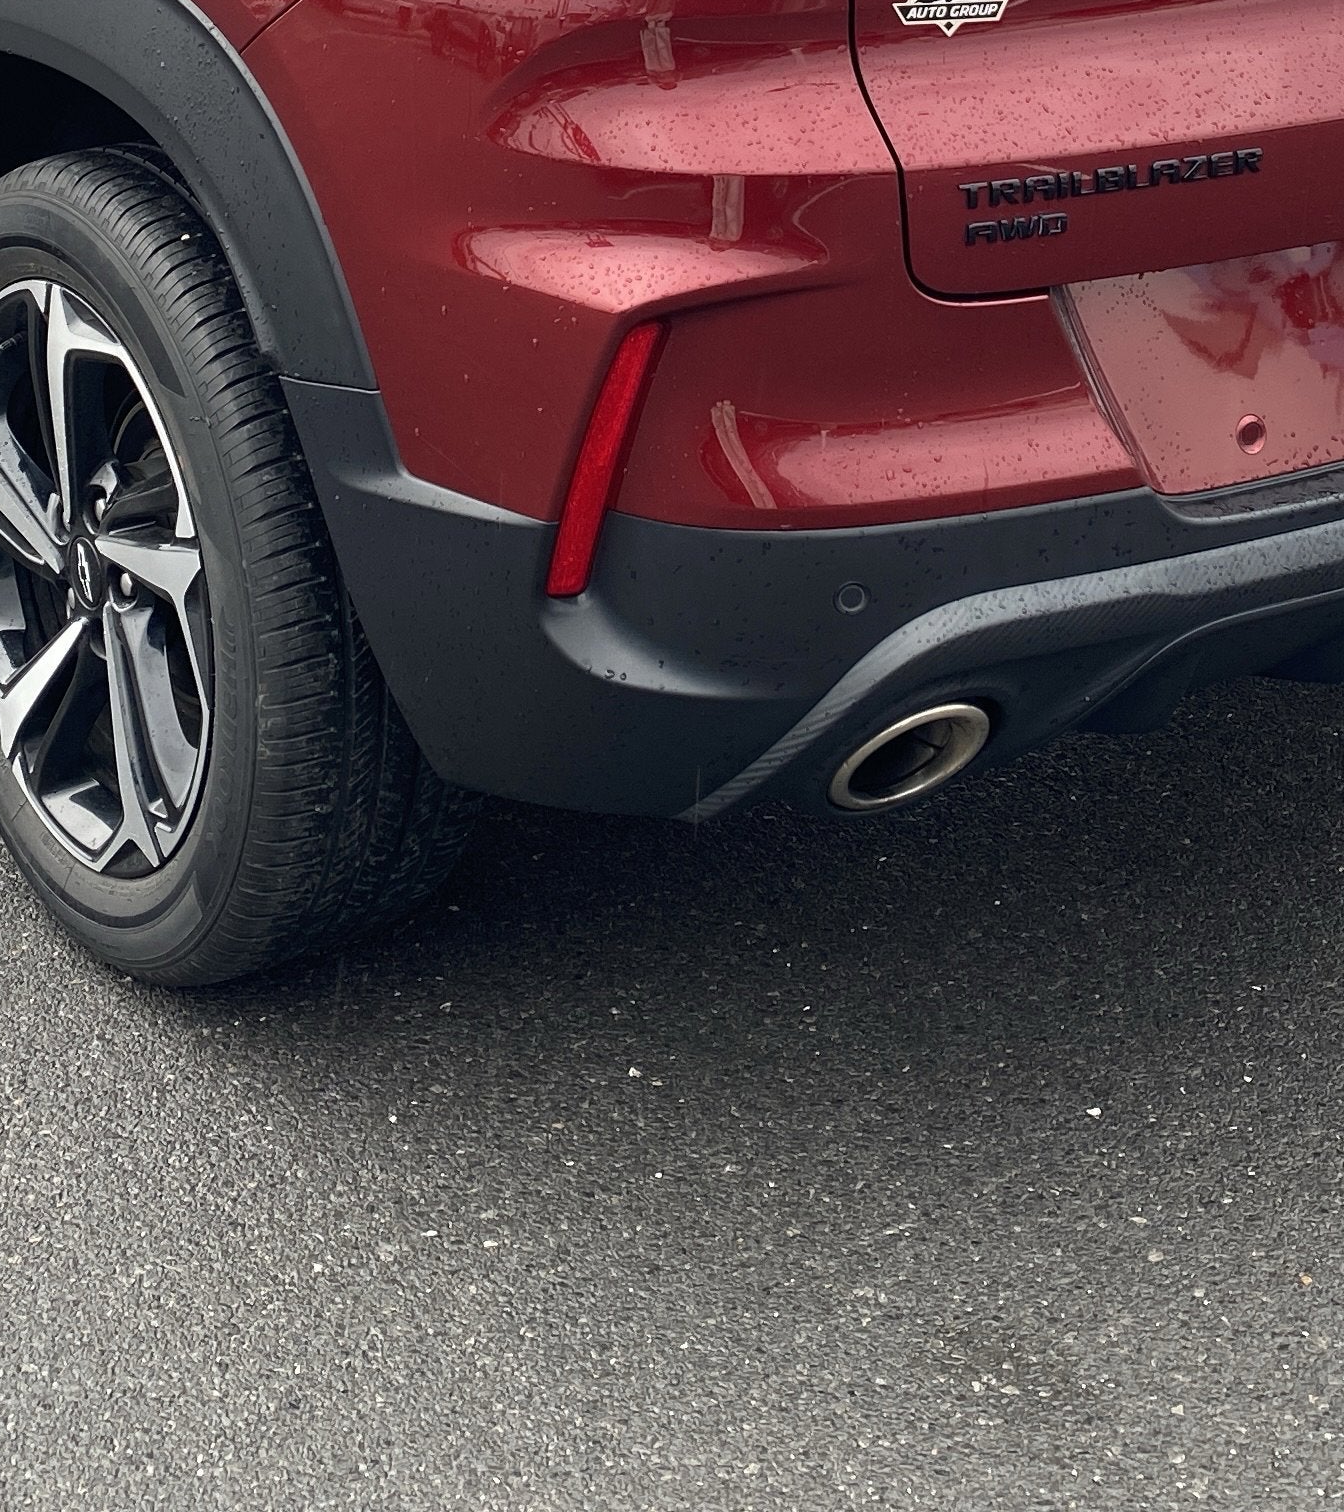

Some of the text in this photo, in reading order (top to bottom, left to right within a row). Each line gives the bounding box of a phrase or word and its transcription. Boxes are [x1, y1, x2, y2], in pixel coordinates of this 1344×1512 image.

[905, 3, 999, 20] AUTO GROUP
[958, 147, 1265, 210] TRAILBLAZER
[963, 211, 1068, 247] AWD
